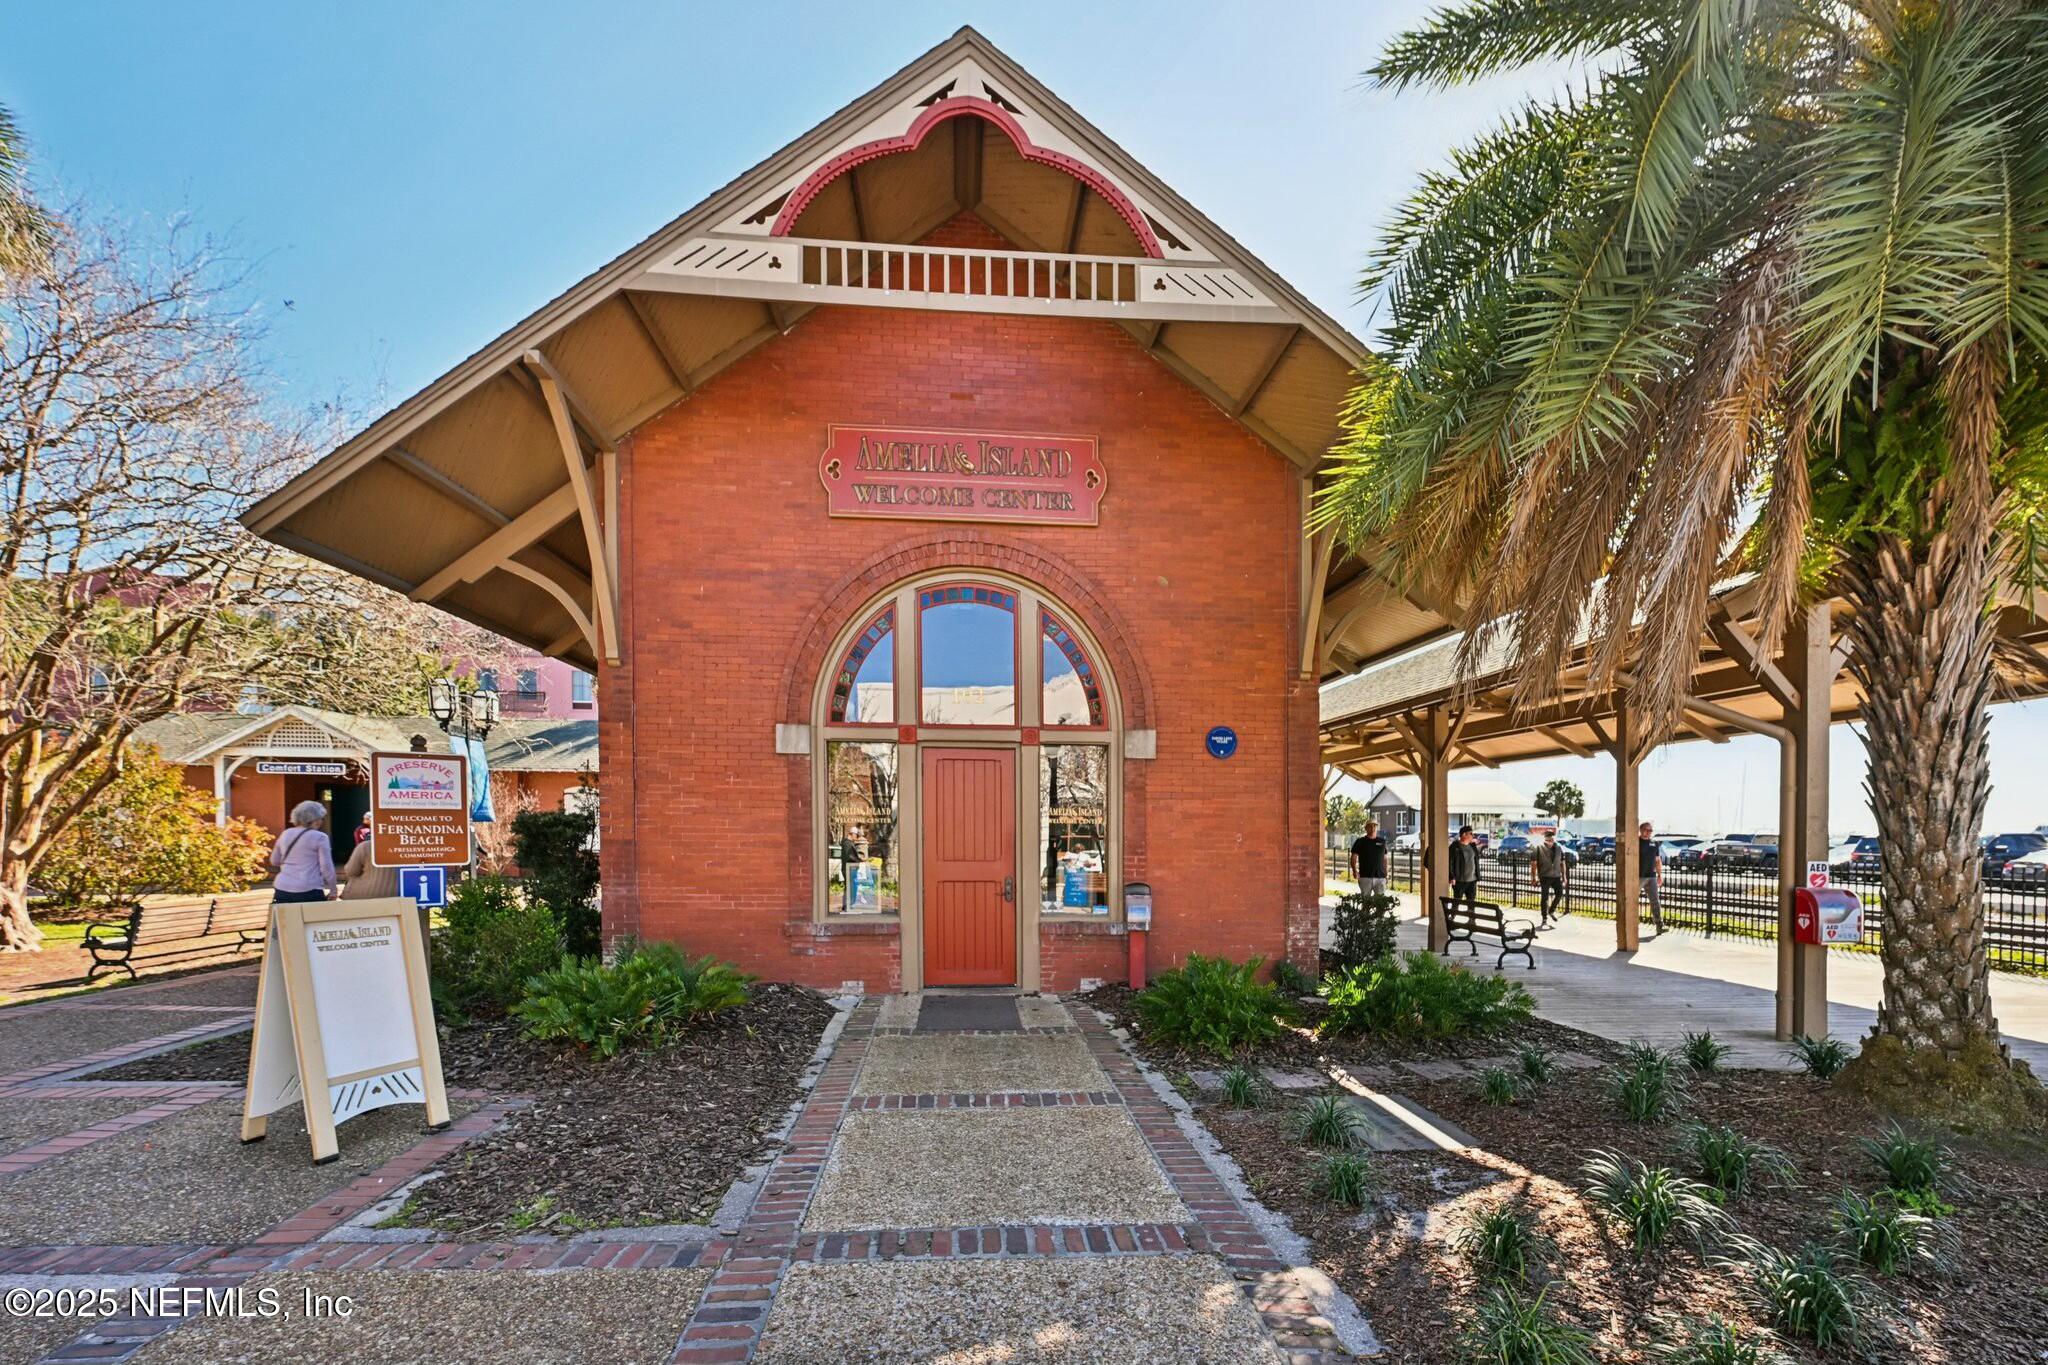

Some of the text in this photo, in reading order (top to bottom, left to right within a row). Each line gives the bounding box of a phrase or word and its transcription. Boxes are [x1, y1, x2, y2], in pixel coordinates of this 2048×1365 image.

[855, 435, 1073, 478] AMELIA ISLAND
[852, 483, 1076, 512] WELCOME CENTER
[261, 764, 341, 773] Comfort Station
[386, 761, 454, 778] PRESERVE
[388, 791, 453, 800] AMERICA
[378, 823, 464, 834] FERNANDINA
[400, 834, 445, 845] BEACH
[1809, 863, 1828, 872] AED
[356, 926, 392, 939] ISLAND
[316, 939, 390, 952] WELCOME CENTER
